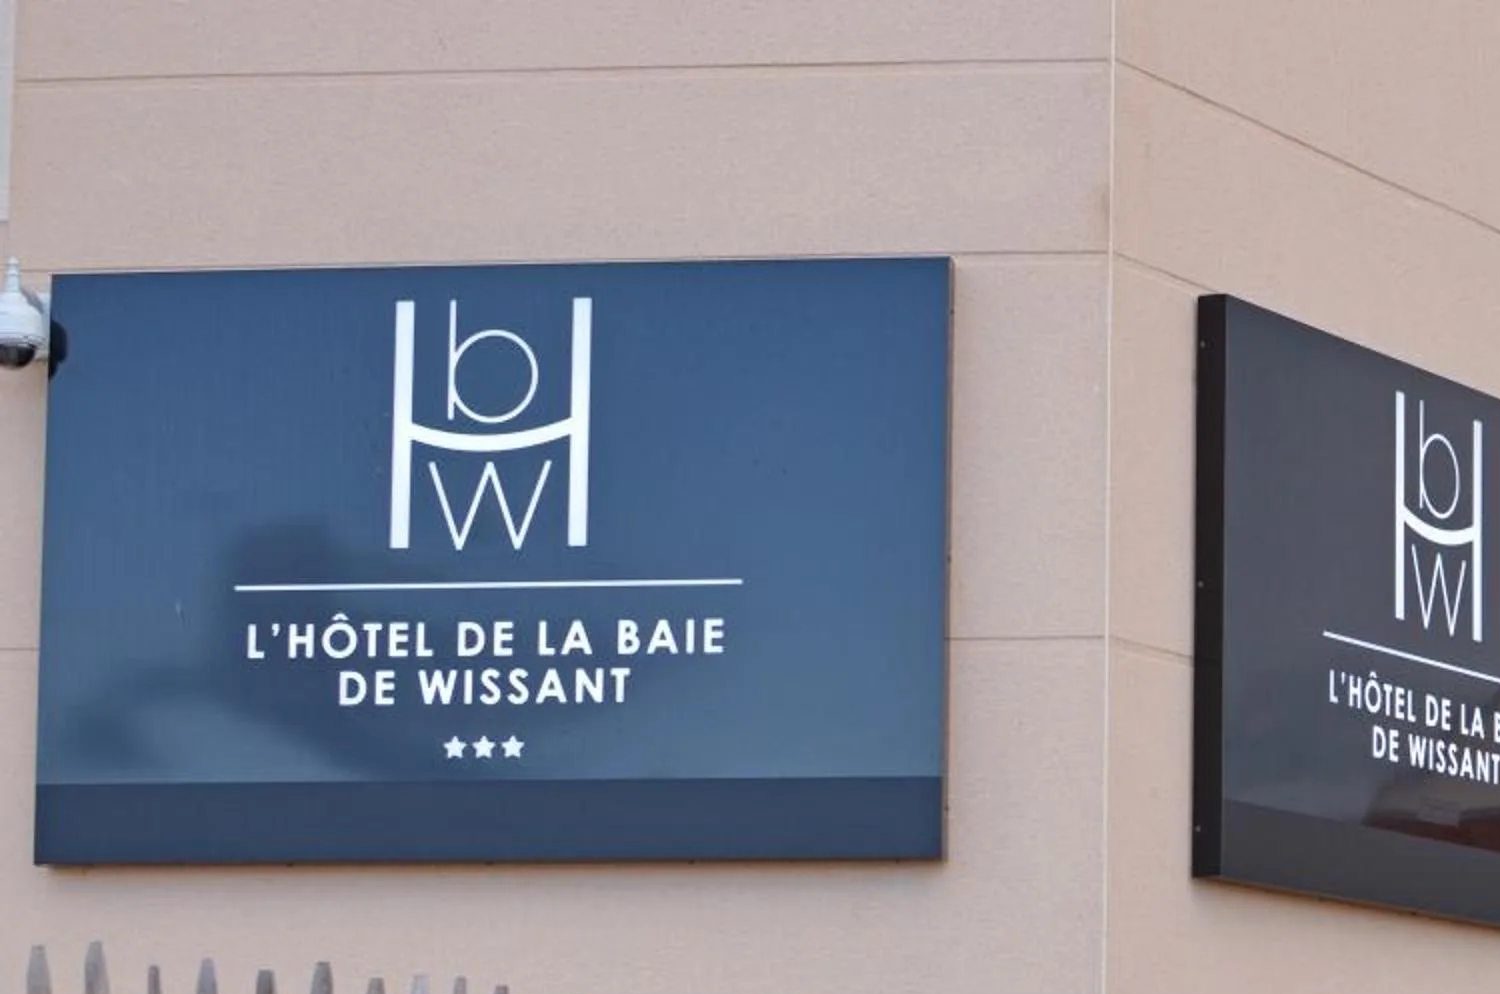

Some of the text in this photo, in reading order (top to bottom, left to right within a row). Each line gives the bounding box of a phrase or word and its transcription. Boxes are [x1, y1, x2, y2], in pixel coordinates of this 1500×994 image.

[246, 612, 725, 660] L'HÔTEL DE LA BAIE
[338, 666, 632, 707] DE WISSANT
[1328, 668, 1418, 724] L'HÔTEL
[1424, 692, 1453, 733] DE
[1459, 702, 1486, 741] LA
[1371, 723, 1401, 764] DE
